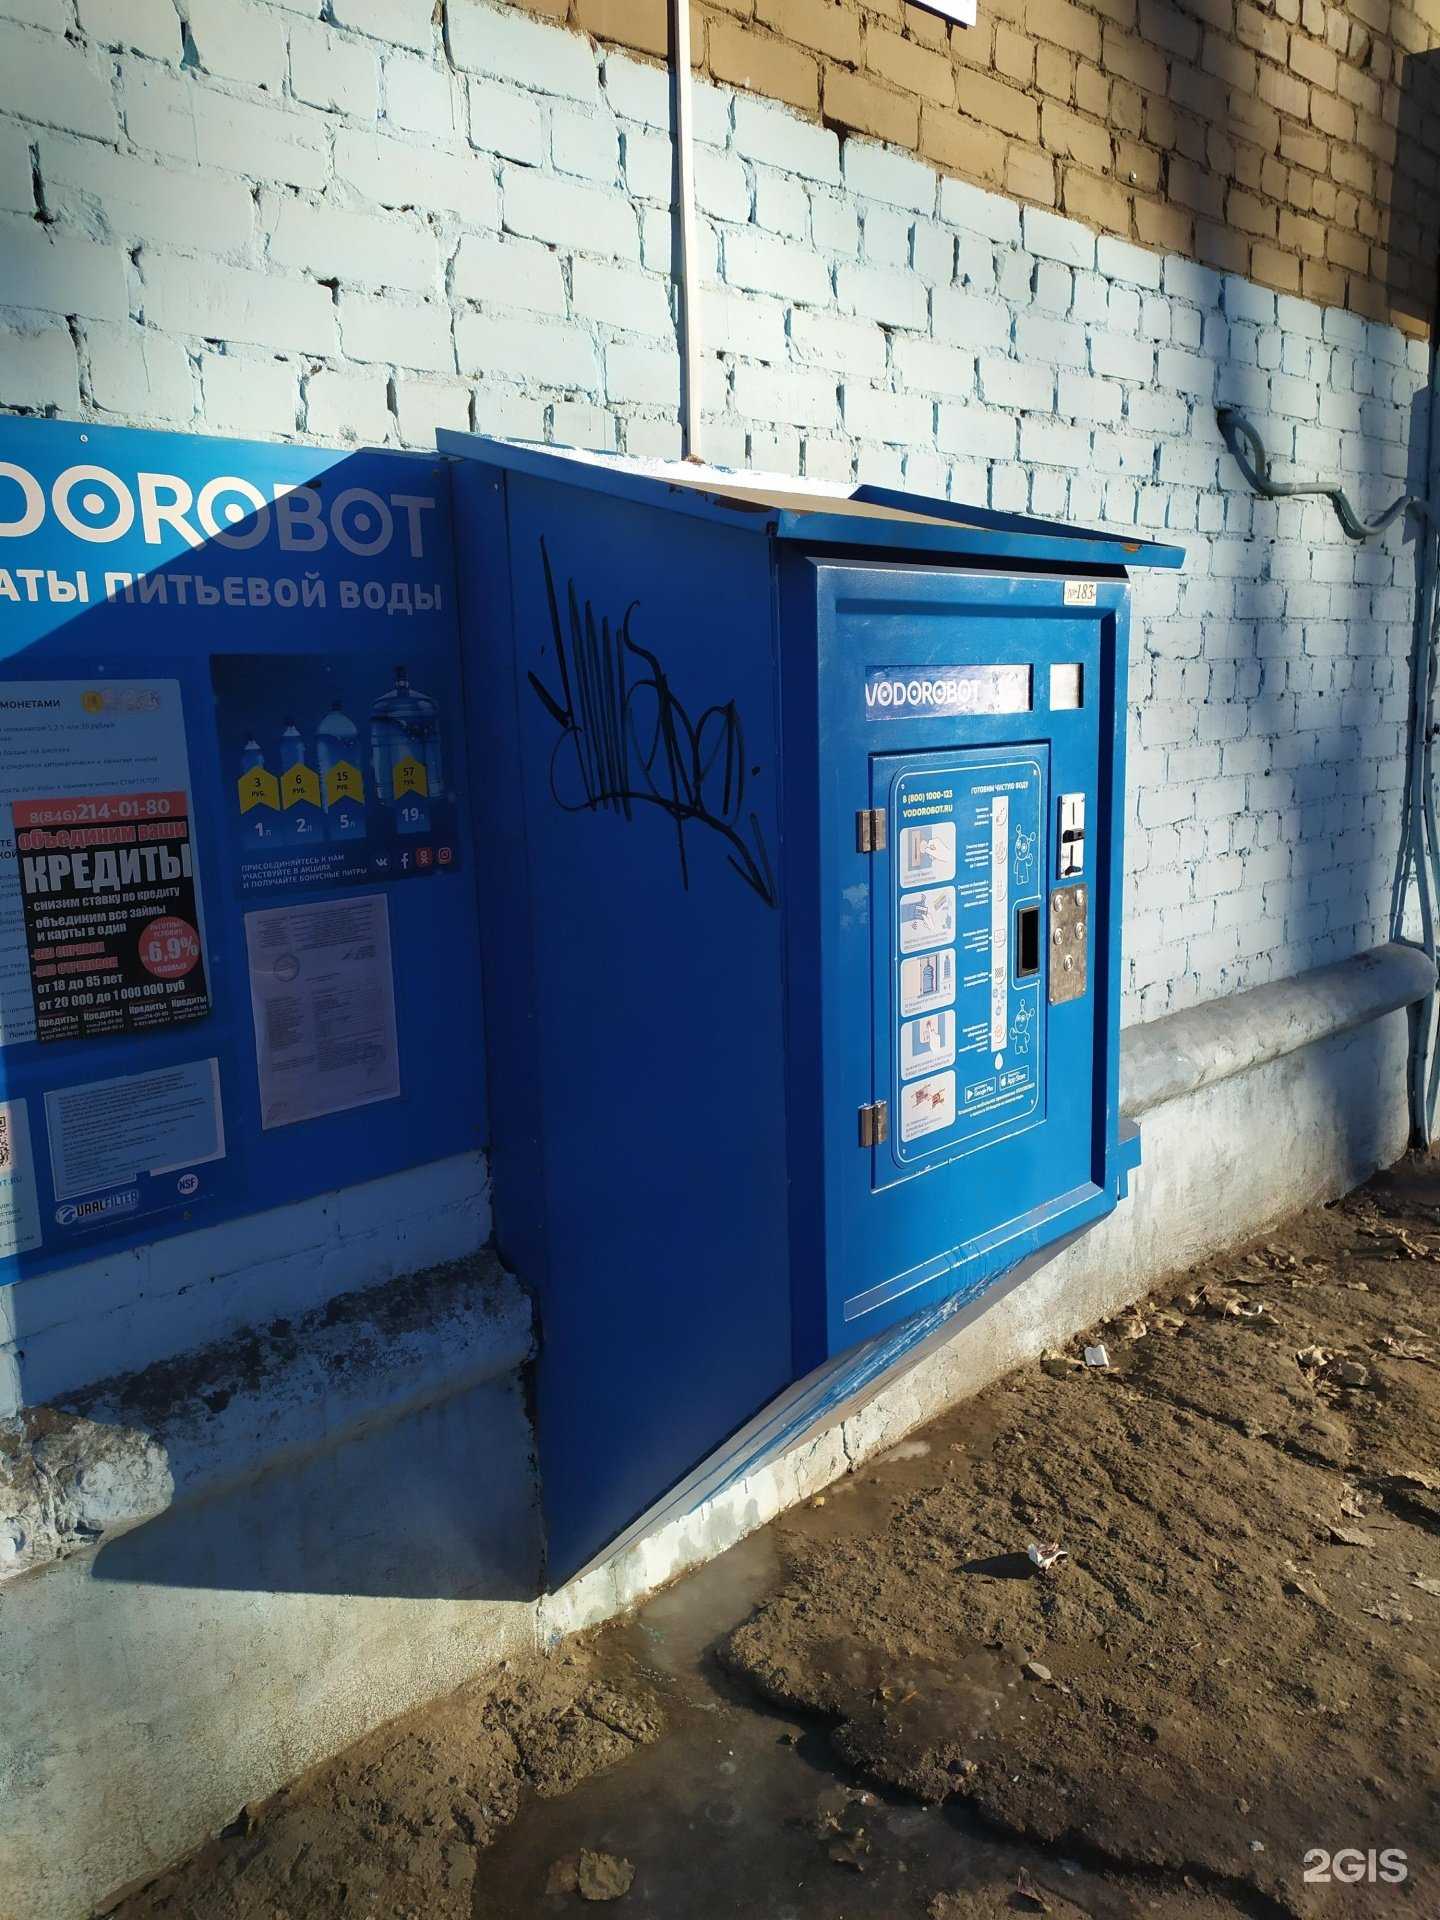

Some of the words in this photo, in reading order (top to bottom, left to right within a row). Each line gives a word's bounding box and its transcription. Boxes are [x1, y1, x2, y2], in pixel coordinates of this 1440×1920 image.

[104, 571, 327, 608] ПИТЬЕВОЙ
[340, 581, 441, 615] ВОДЫ
[865, 680, 981, 706] VODOROBOT
[255, 777, 261, 788] 3
[295, 774, 302, 784] 6
[337, 771, 348, 782] 15
[403, 767, 415, 777] 57
[30, 799, 170, 824] 8(846)214-01-80
[902, 804, 953, 818] VODOROBOT.RU
[23, 843, 193, 894] КРЕДИТЫ
[34, 898, 80, 912] снизим
[82, 894, 121, 907] ставку
[122, 892, 136, 903] по
[137, 887, 180, 901] кредиту
[36, 911, 106, 929] объединим
[108, 909, 128, 920] все
[129, 904, 166, 919] займы
[37, 932, 46, 942] и
[47, 927, 85, 941] карты
[88, 926, 96, 936] в
[97, 922, 127, 936] один
[37, 983, 51, 994] от
[53, 980, 66, 992] 18
[68, 978, 83, 990] до
[86, 975, 100, 988] 85
[102, 973, 124, 985] лет
[39, 1000, 53, 1011] от
[96, 992, 111, 1004] до
[165, 980, 185, 995] руб
[178, 1177, 196, 1191] NSF
